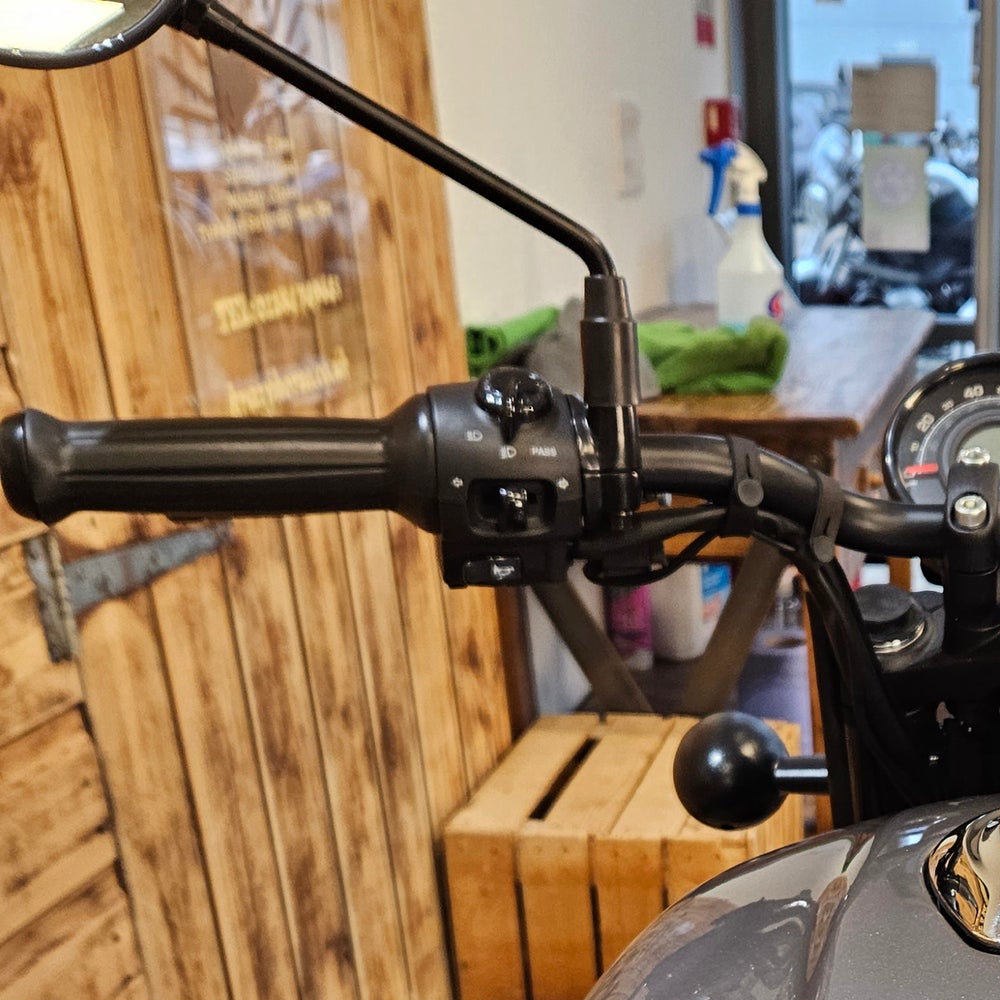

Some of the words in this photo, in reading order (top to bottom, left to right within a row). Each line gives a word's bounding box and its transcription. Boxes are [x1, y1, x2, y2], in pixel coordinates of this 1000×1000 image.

[963, 384, 985, 399] 40
[916, 412, 935, 433] 20
[532, 446, 557, 457] PASS
